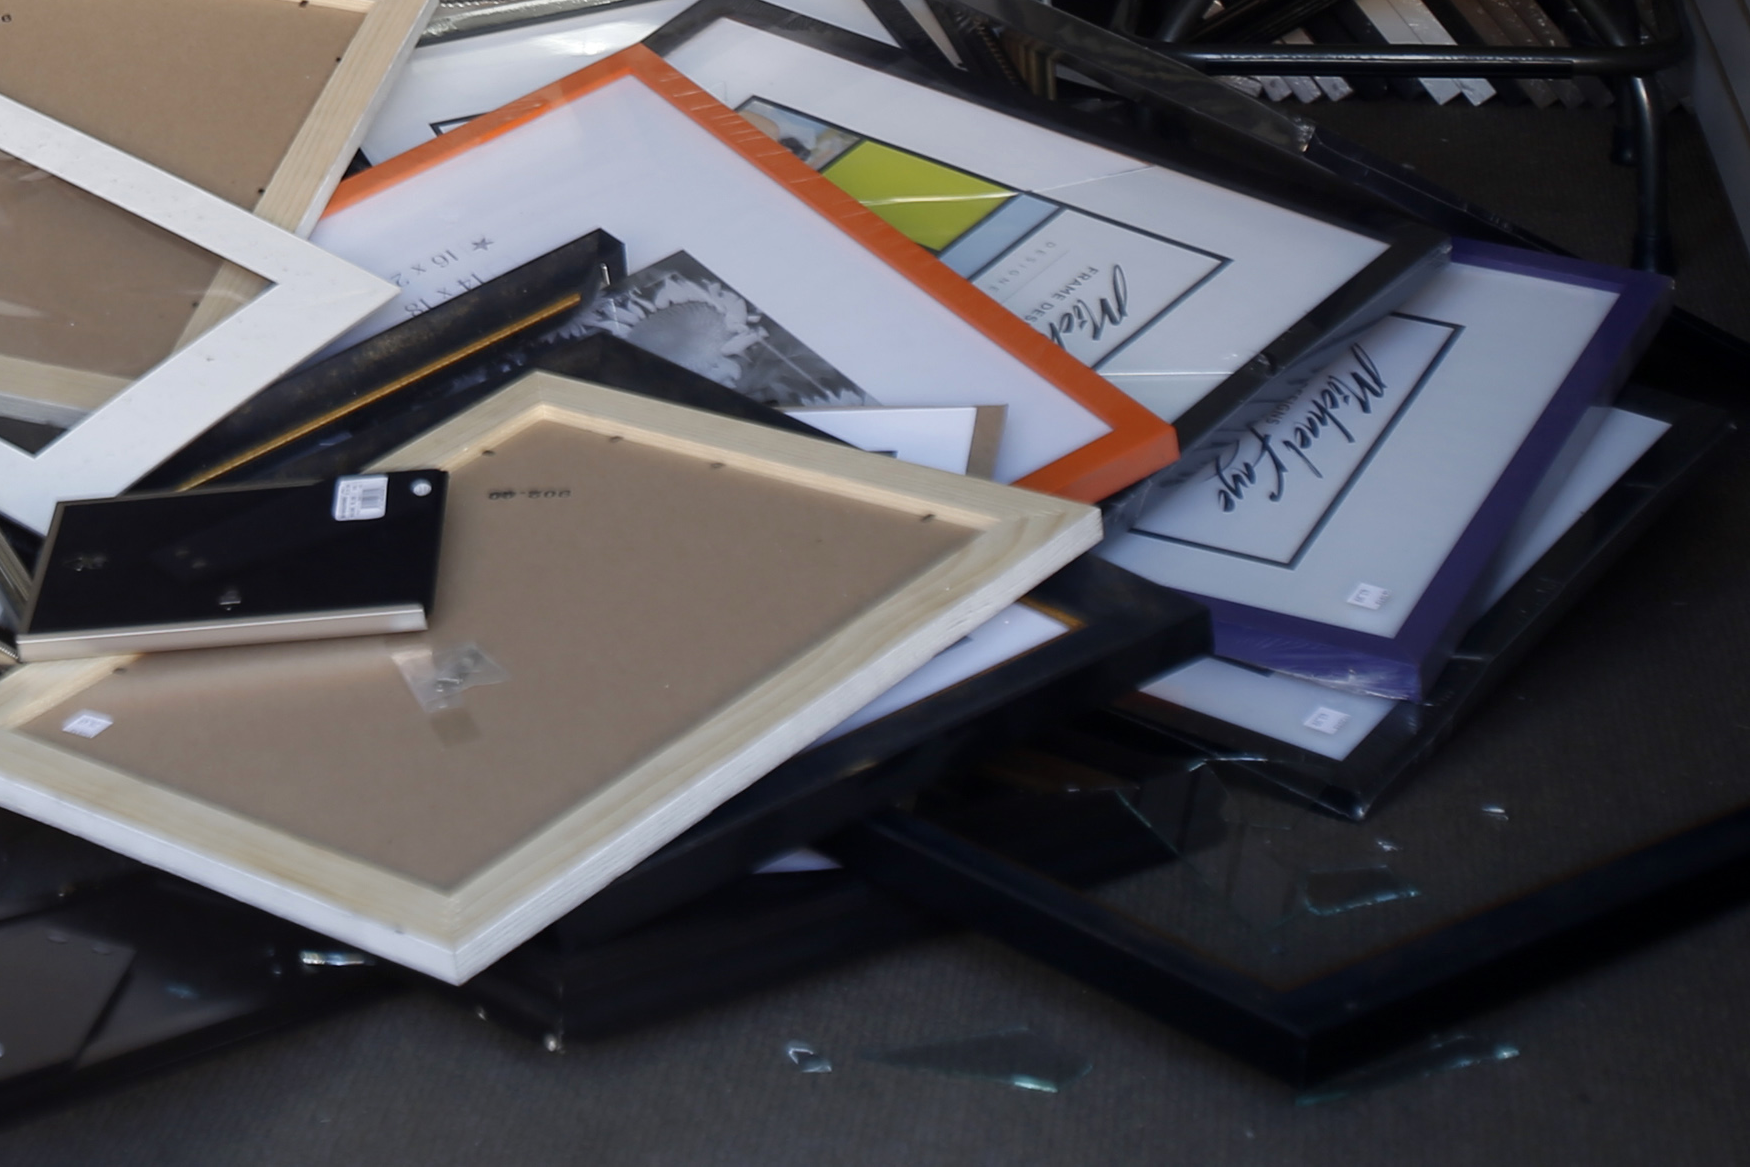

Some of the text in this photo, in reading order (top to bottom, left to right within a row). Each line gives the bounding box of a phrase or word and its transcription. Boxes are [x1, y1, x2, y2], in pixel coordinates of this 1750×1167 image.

[390, 249, 459, 288] 16 x 2
[988, 240, 1057, 293] DESIGNE
[1024, 265, 1100, 323] FRAME DES
[405, 273, 486, 317] 14 x 18
[1049, 264, 1129, 350] Mich
[1207, 342, 1388, 514] Michael Faye
